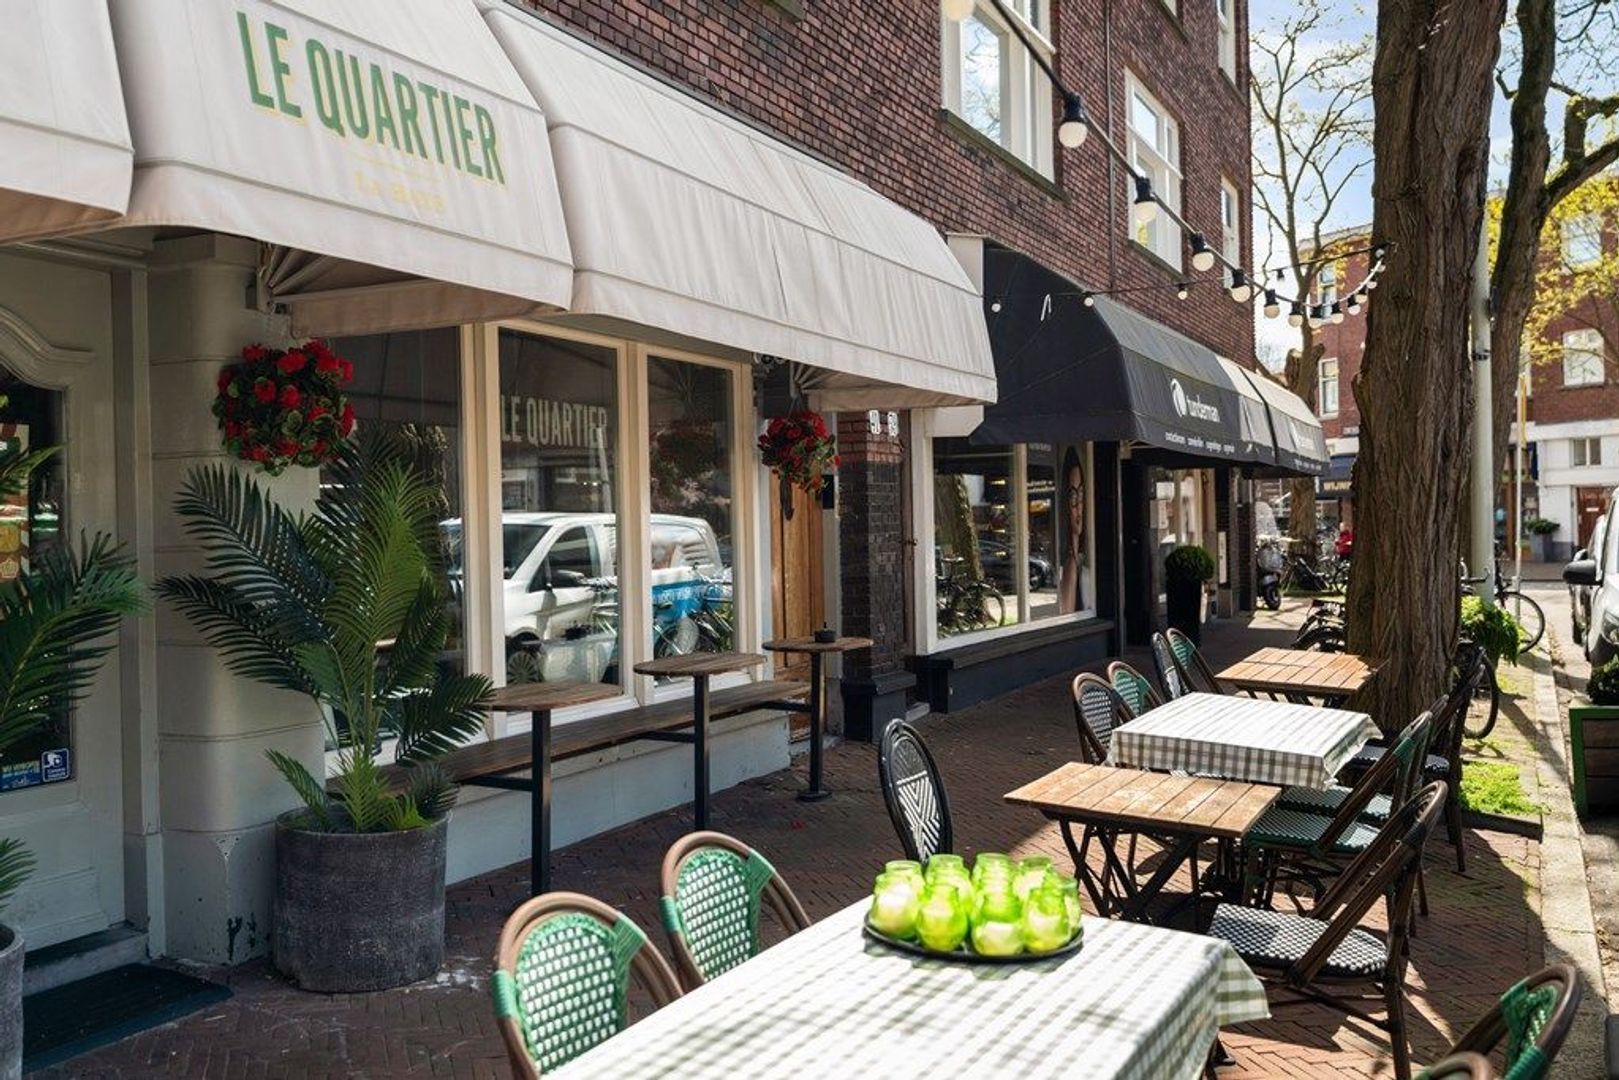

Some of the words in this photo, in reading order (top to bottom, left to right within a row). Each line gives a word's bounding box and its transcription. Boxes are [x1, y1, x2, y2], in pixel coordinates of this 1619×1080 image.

[237, 11, 303, 119] LE
[305, 38, 506, 186] QUARTIER
[501, 394, 522, 442] LE
[526, 397, 608, 449] QUARTIER
